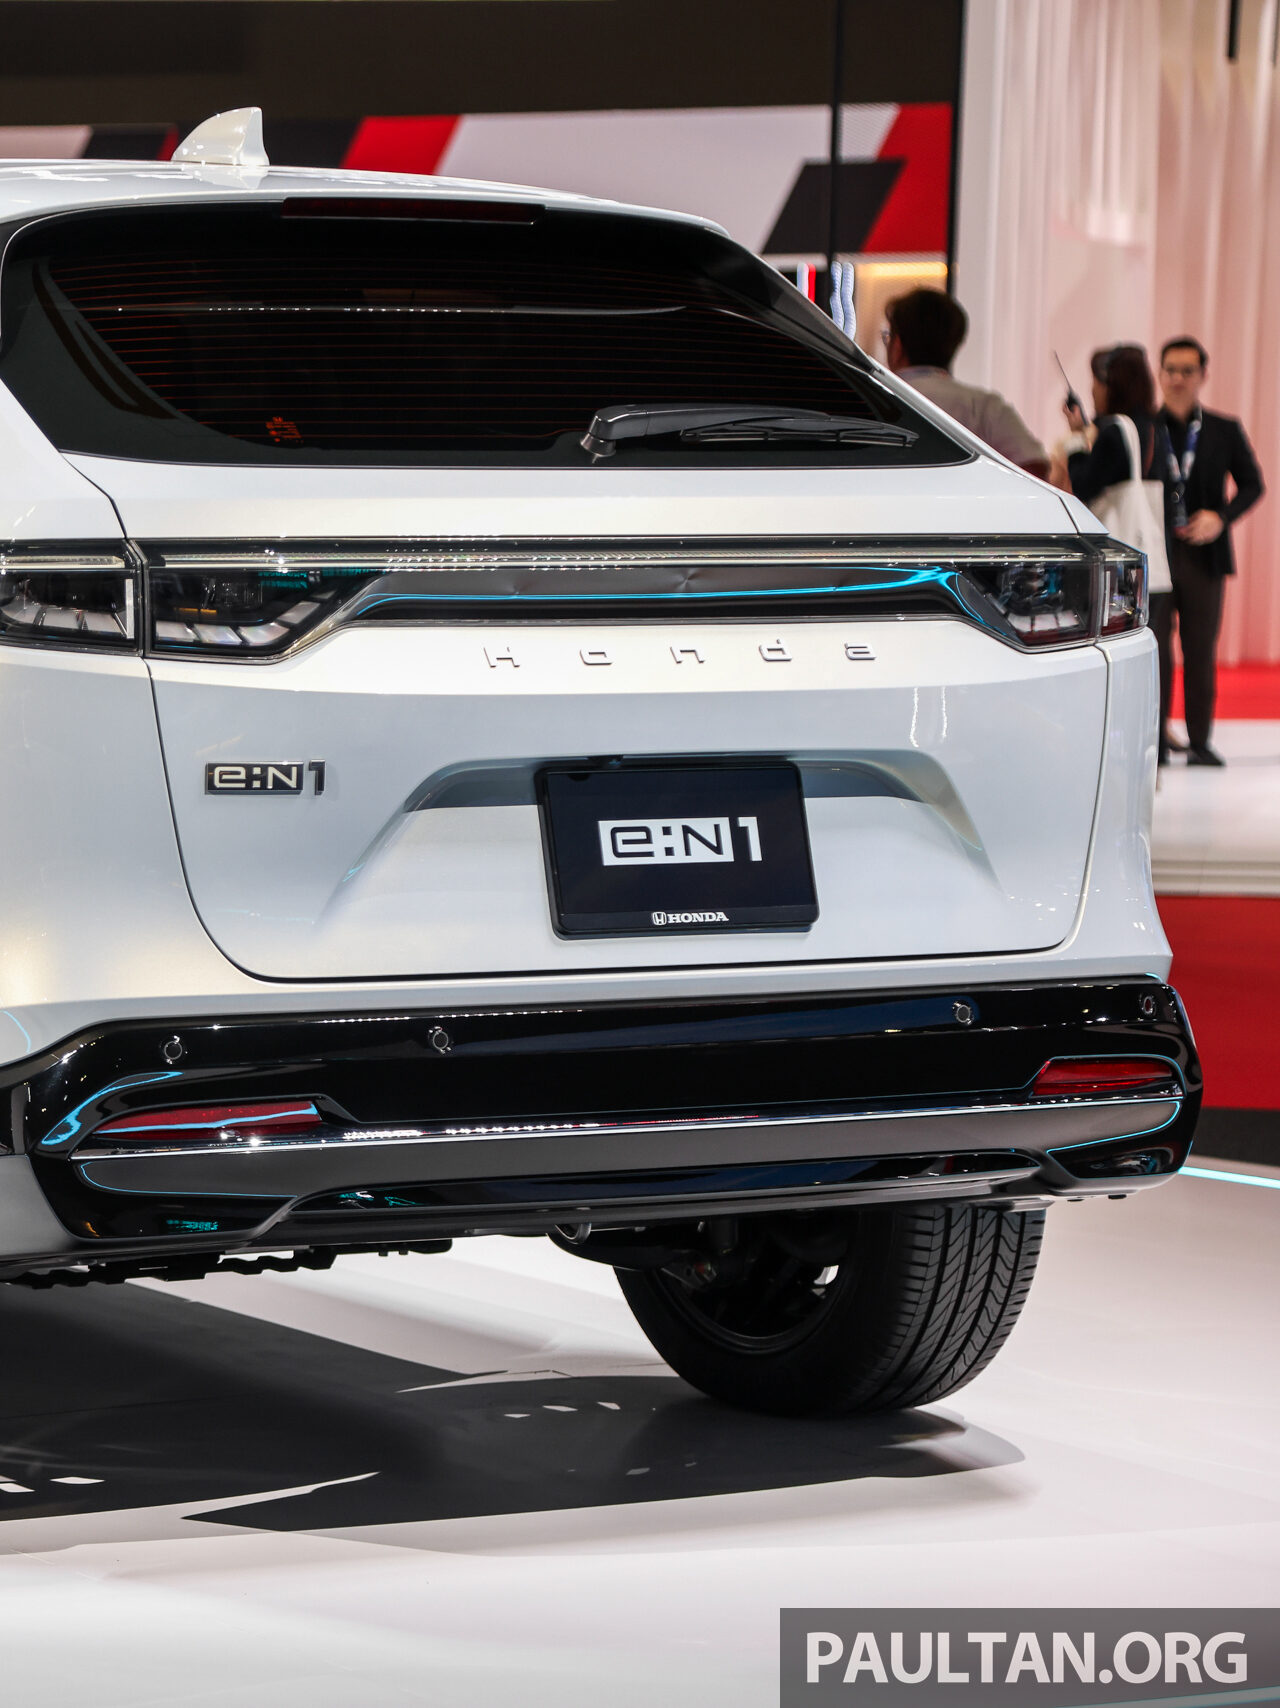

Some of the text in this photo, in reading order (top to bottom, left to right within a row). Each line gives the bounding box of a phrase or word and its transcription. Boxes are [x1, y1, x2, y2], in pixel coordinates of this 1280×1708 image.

[483, 638, 878, 669] Honda
[208, 759, 326, 796] e:N1
[600, 815, 763, 866] e:N1
[667, 911, 730, 924] HONDA
